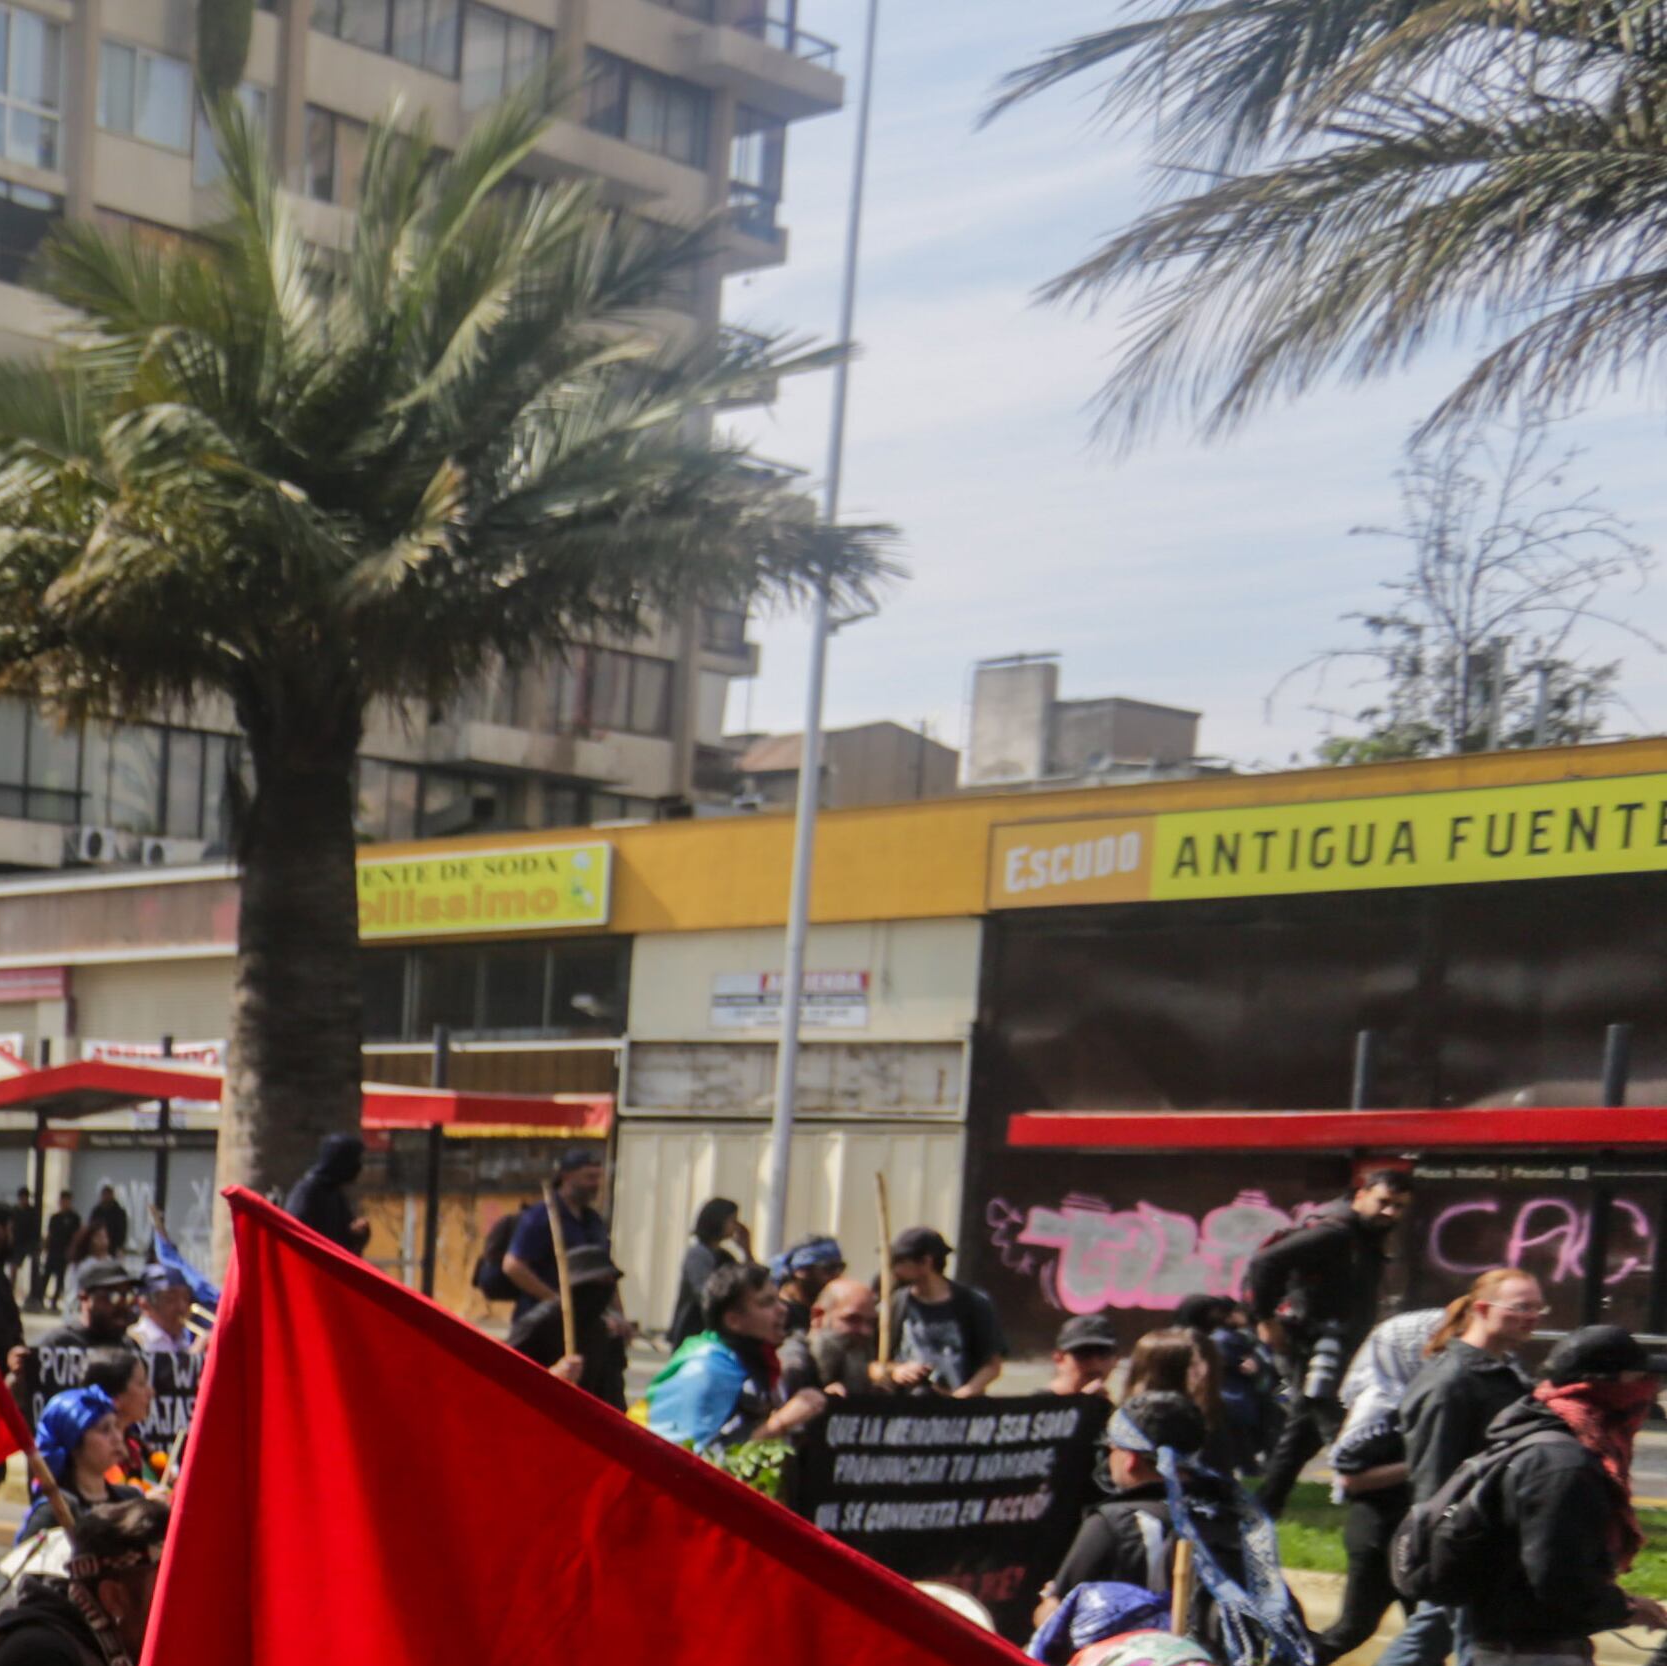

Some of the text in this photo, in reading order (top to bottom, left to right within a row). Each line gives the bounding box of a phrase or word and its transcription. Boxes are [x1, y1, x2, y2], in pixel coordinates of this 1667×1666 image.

[1169, 818, 1418, 881] ANTIGUA
[363, 853, 560, 888] ENTE DE SODA
[826, 1414, 861, 1447] QUE
[859, 1413, 884, 1445] LA
[882, 1414, 968, 1446] MEMORIA
[966, 1414, 997, 1445] NO
[833, 1446, 1057, 1486] PRONUNCIAR TU NOMBRE
[840, 1501, 867, 1532] SE
[863, 1500, 960, 1533] CONVIERTA
[957, 1498, 987, 1527] EN
